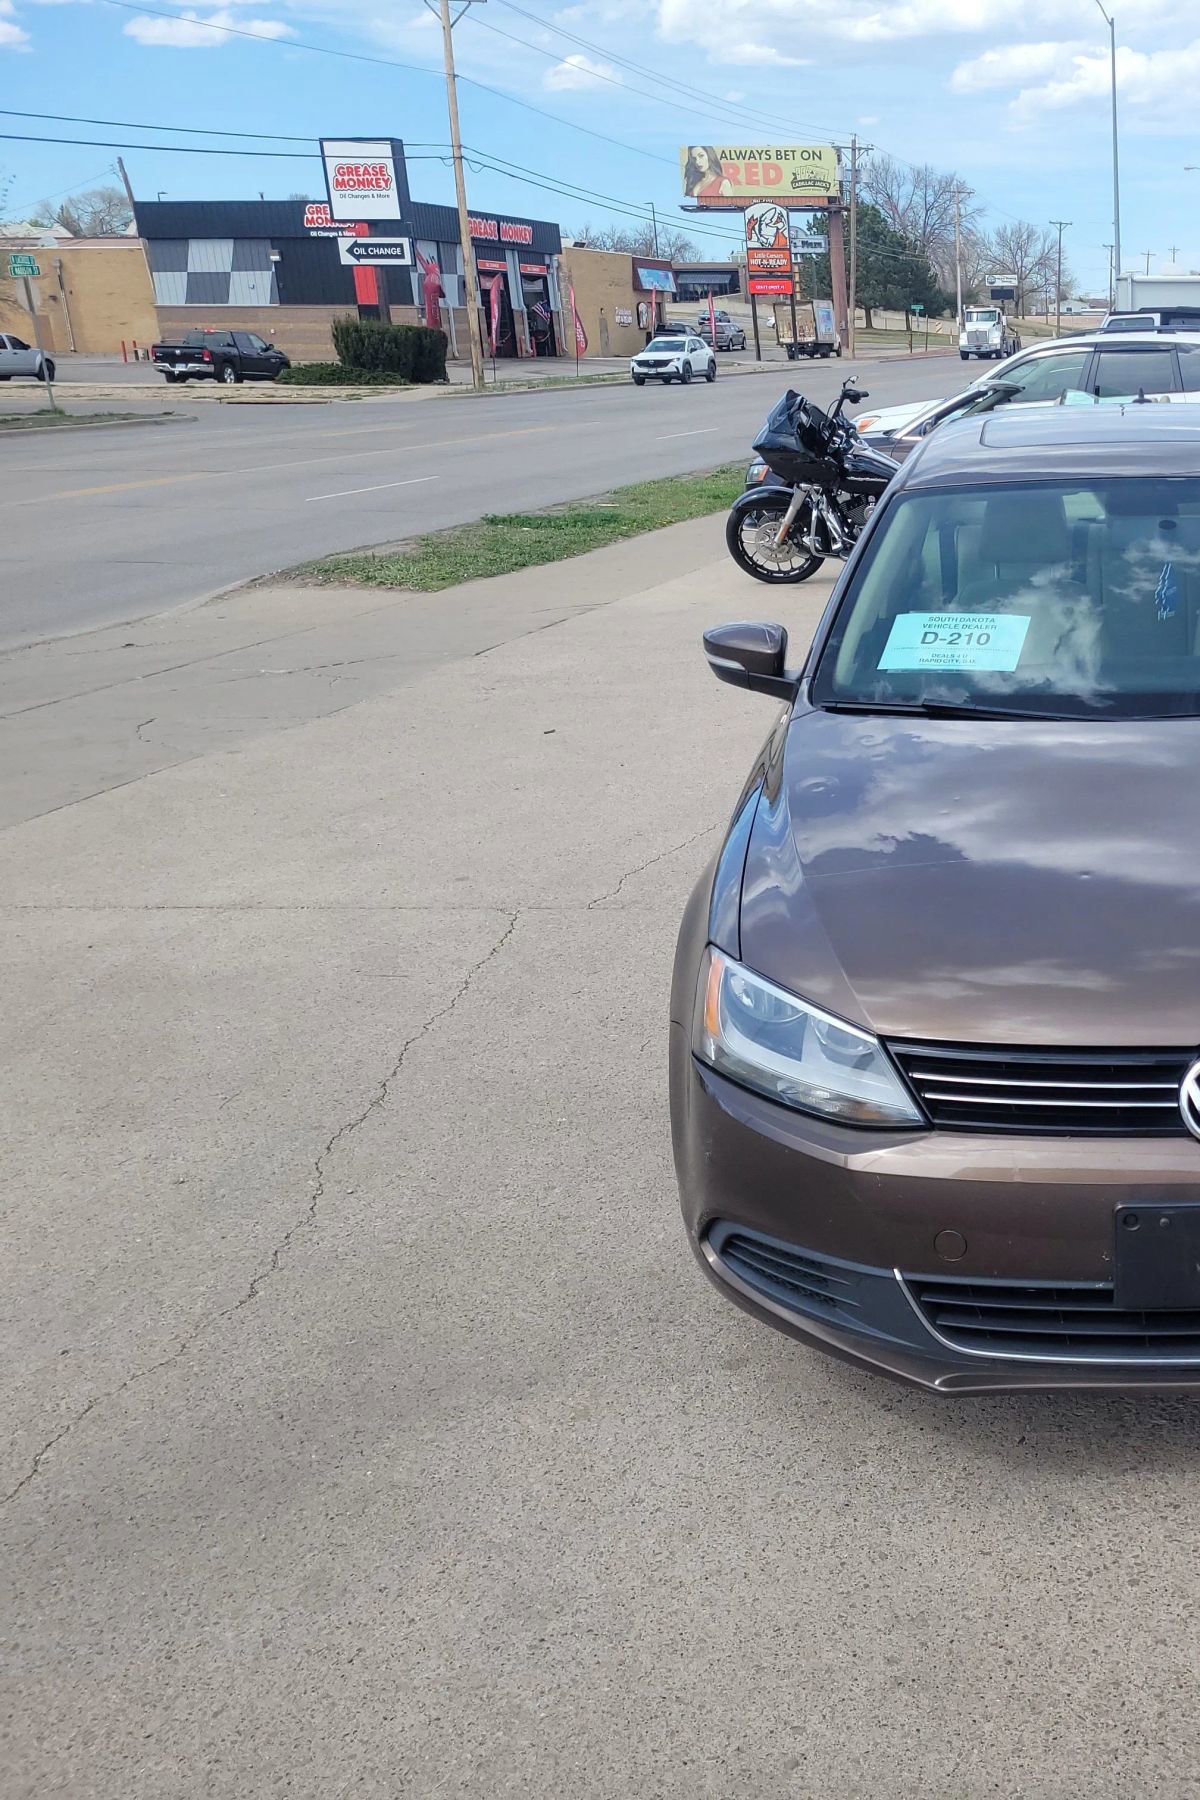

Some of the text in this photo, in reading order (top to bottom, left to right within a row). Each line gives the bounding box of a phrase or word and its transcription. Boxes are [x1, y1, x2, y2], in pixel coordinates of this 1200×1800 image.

[720, 149, 822, 161] ALWAYS BET ON
[336, 164, 387, 178] GREASE
[722, 162, 784, 186] RED
[334, 177, 391, 189] MONKEY
[306, 204, 330, 216] GRE
[500, 221, 532, 244] MONKEY
[353, 247, 402, 255] OIL CHANGE
[920, 631, 991, 646] D-210
